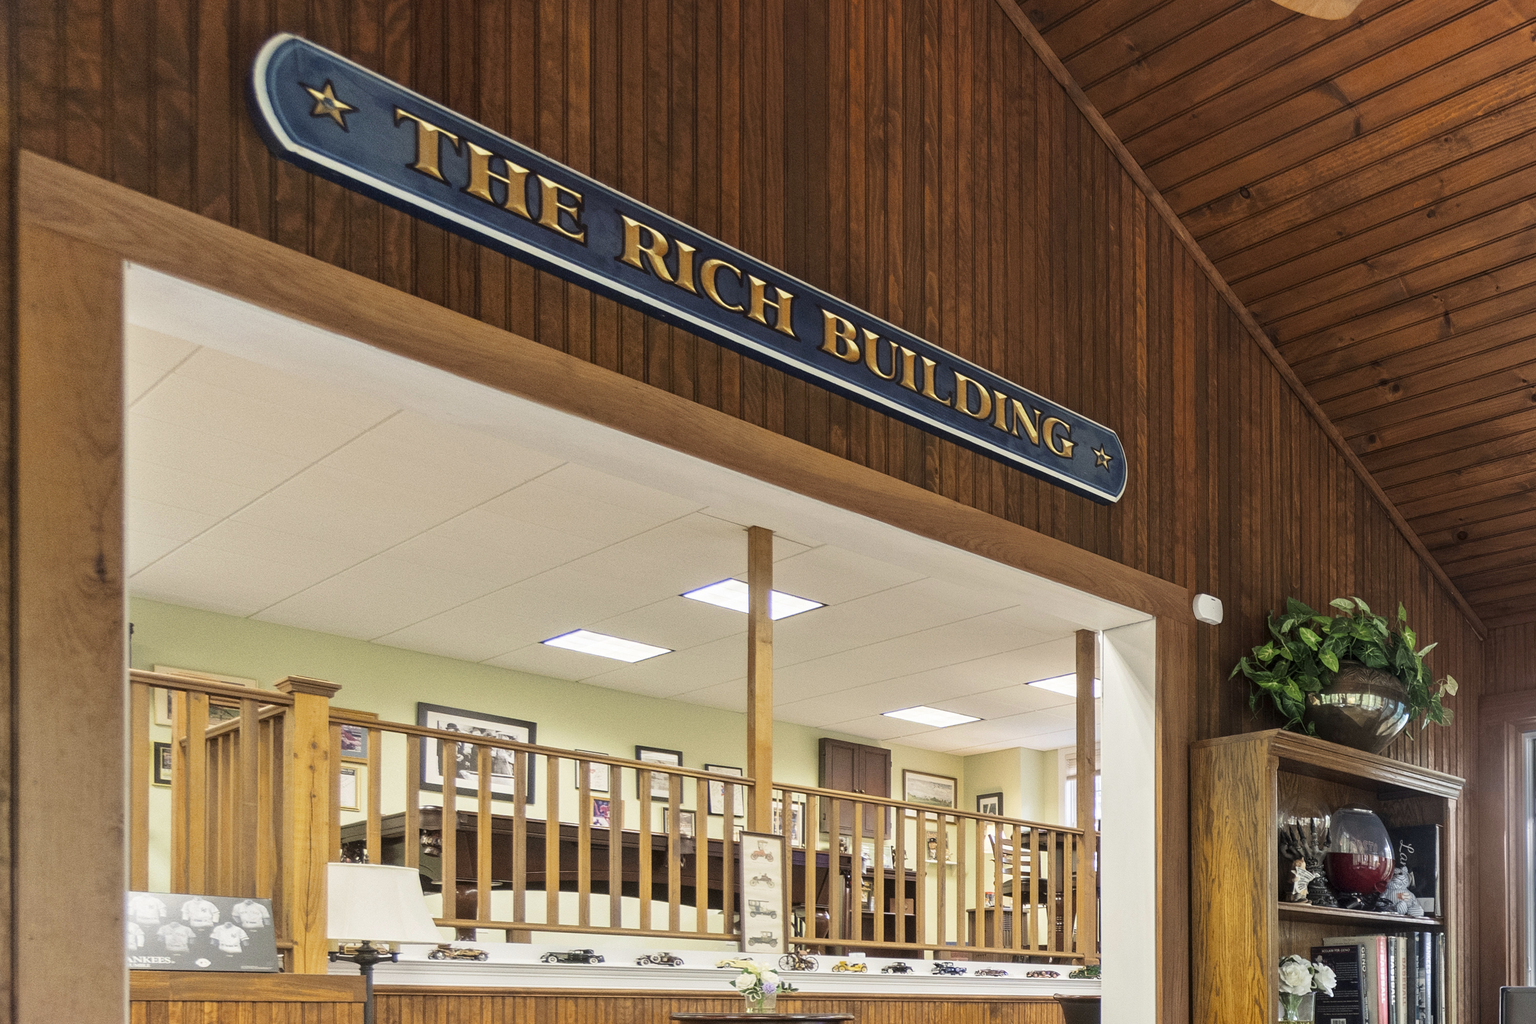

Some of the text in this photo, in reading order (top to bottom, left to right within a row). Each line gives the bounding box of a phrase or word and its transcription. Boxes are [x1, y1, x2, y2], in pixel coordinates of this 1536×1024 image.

[394, 106, 1076, 460] THE RICH BUILDING
[127, 955, 172, 964] ANKEES
